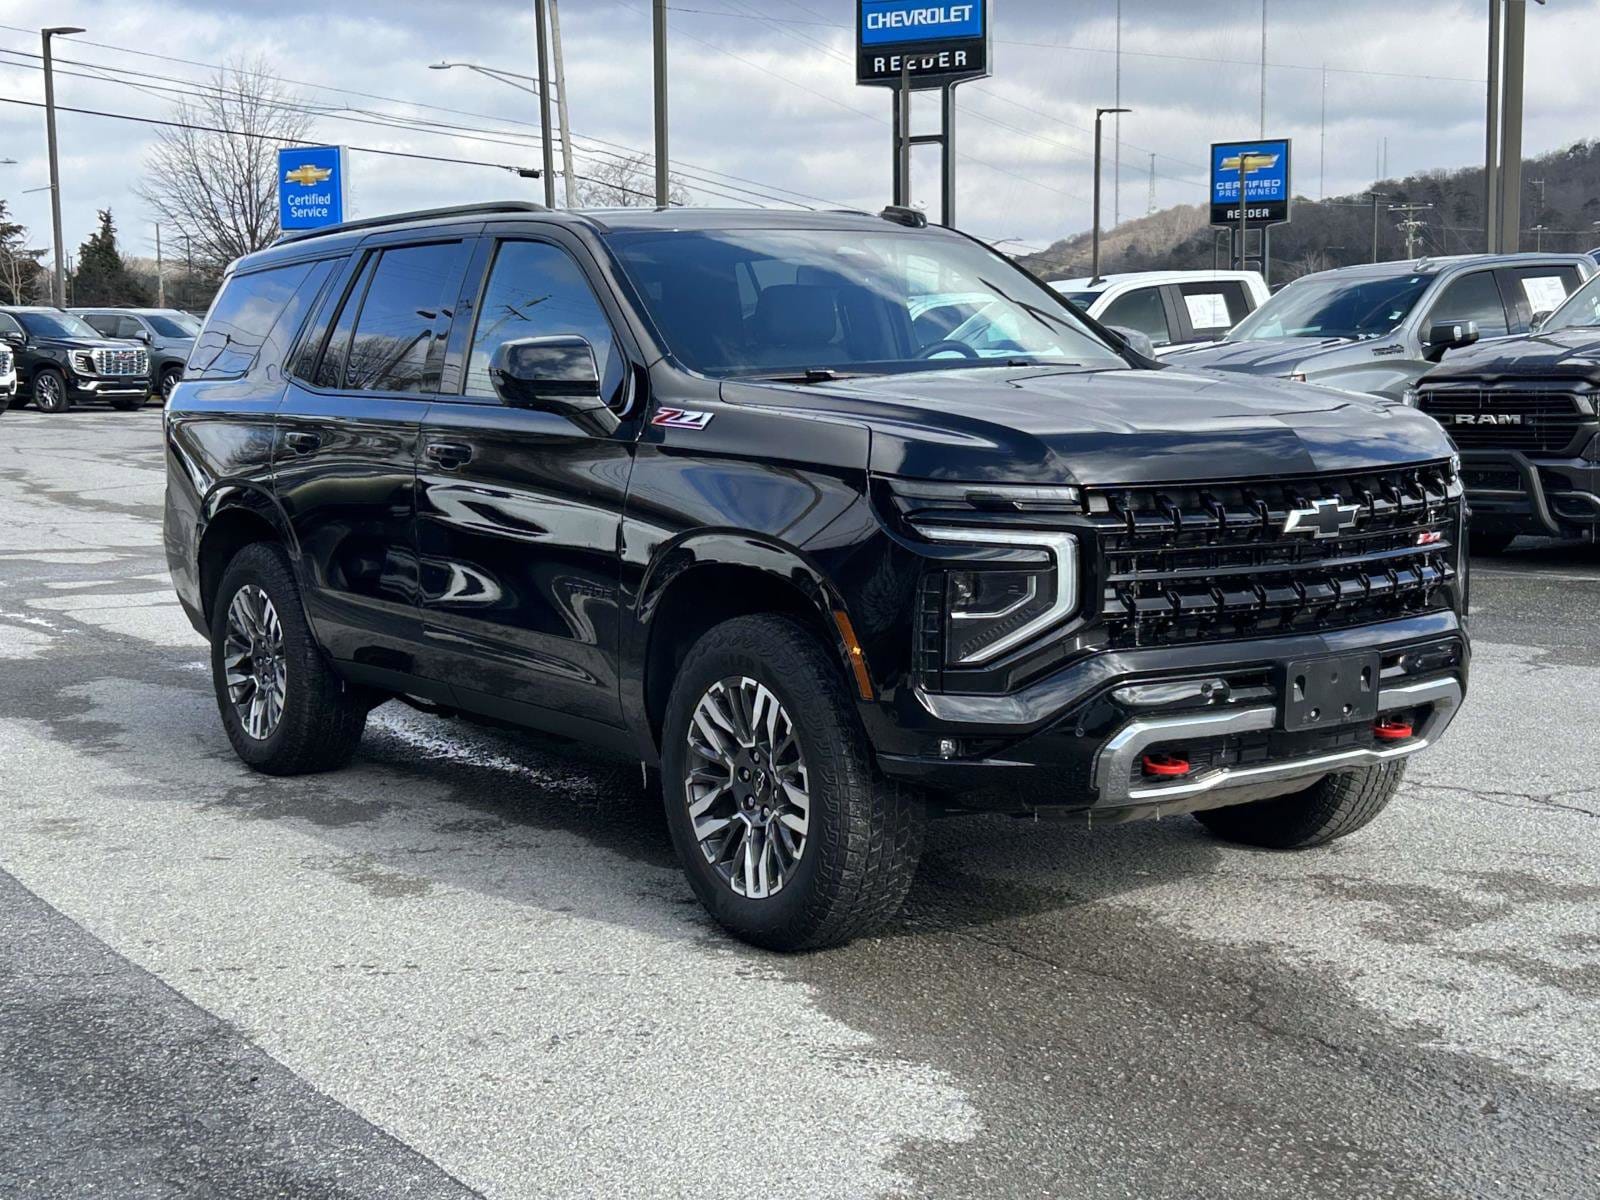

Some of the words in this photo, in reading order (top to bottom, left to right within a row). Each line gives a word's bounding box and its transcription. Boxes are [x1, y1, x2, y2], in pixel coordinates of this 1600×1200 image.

[867, 5, 973, 30] CHEVROLET
[287, 193, 331, 206] Certified
[291, 206, 328, 218] Service
[1455, 414, 1521, 425] RAM
